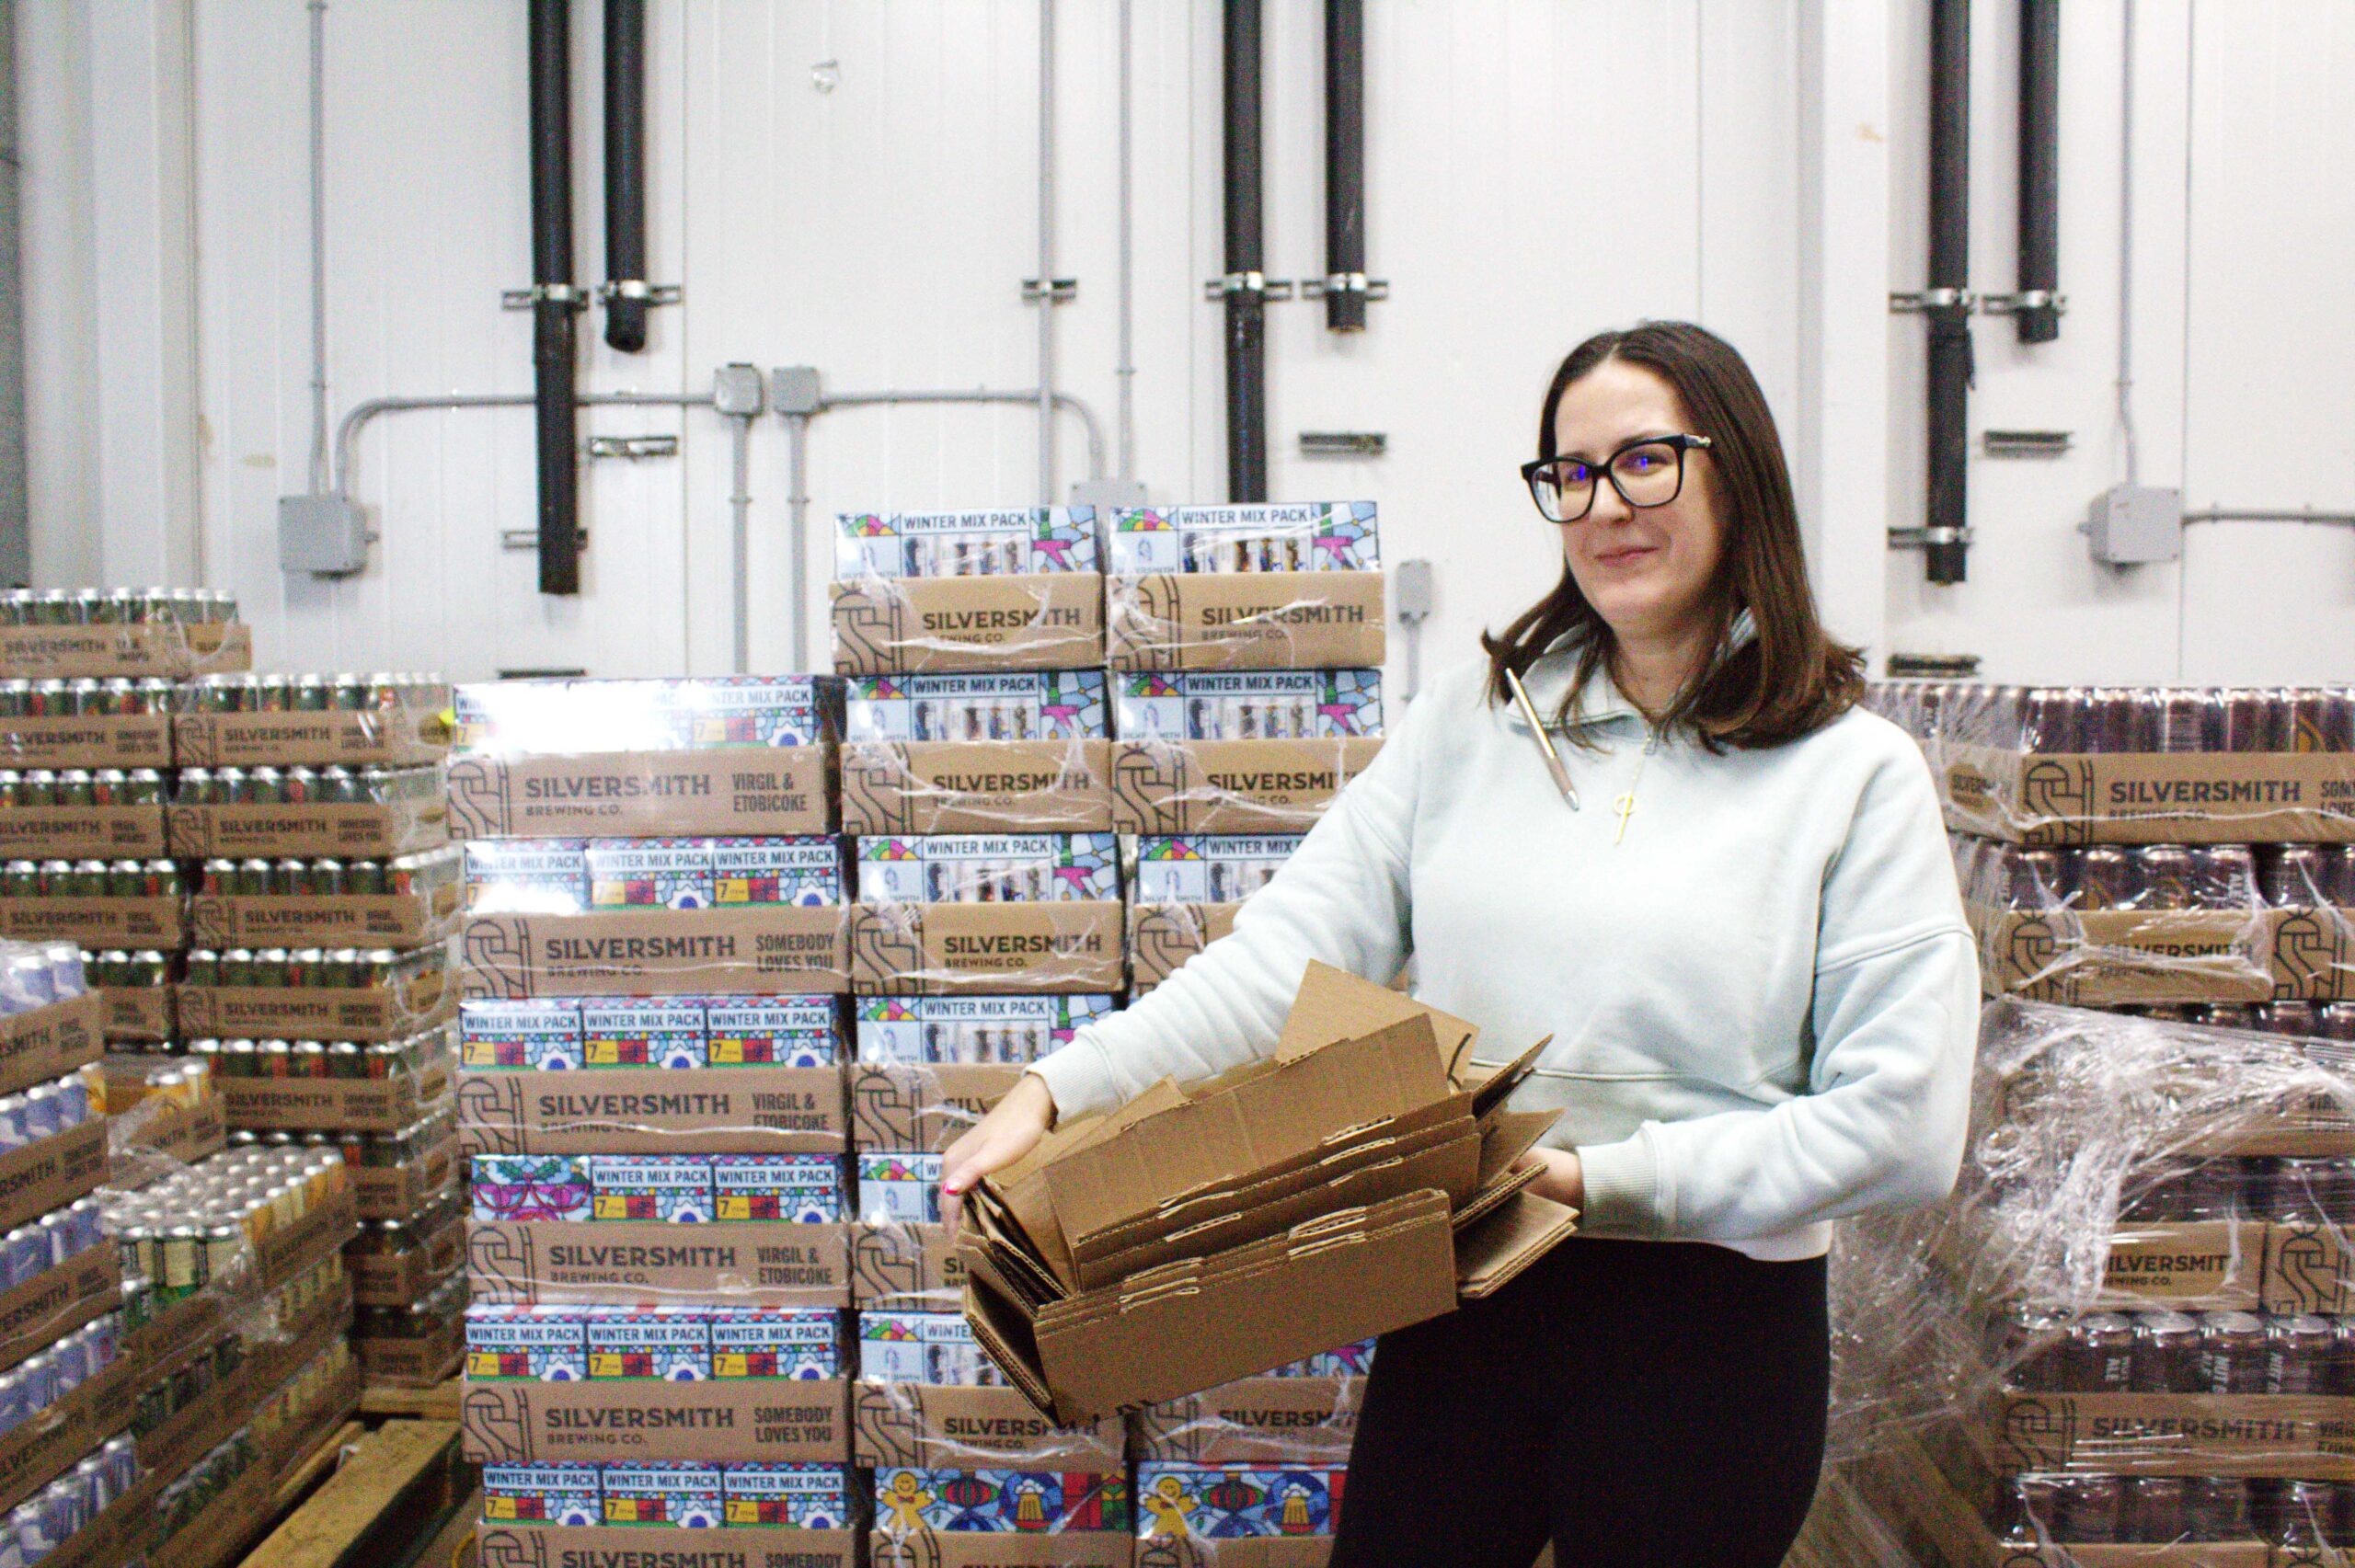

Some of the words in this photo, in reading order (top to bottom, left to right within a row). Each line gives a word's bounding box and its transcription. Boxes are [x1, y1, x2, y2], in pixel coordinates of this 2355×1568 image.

[904, 514, 957, 529] WINTER
[961, 513, 986, 528] MIX
[991, 513, 1027, 527] PACK
[1182, 510, 1235, 524] WINTER
[1241, 509, 1266, 523] MIX
[1271, 509, 1307, 521] PACK
[1201, 605, 1363, 625] SILVERSMITH
[913, 680, 966, 693] WINTER
[971, 679, 996, 692] MIX
[1001, 678, 1035, 691] PACK
[1189, 677, 1241, 691] WINTER
[1246, 677, 1272, 691] MIX
[1276, 676, 1312, 690] PACK
[748, 690, 772, 704] MIX
[775, 689, 810, 703] PACK
[732, 773, 778, 790] VIRGIL
[784, 773, 794, 790] &
[1207, 772, 1355, 791] SILVERSMI
[2109, 780, 2301, 804] SILVERSMITH
[733, 794, 808, 812] ETOBICOKE
[525, 806, 593, 817] BREWING
[926, 841, 979, 854] WINTER
[983, 840, 1008, 853] MIX
[1013, 839, 1048, 853] PACK
[1210, 841, 1261, 854] WINTER
[1267, 840, 1292, 853] MIX
[547, 855, 580, 869] PACK
[649, 853, 671, 867] MIX
[675, 853, 709, 866] PACK
[717, 852, 766, 865] WINTER
[771, 851, 794, 864] MIX
[798, 850, 833, 863] PACK
[718, 882, 728, 899] 7
[546, 936, 736, 959] SILVERSMITH
[755, 933, 835, 952] SOMEBODY
[944, 934, 1101, 955] SILVERSMITH
[757, 956, 801, 972] LOVES
[805, 955, 833, 971] YOU
[945, 958, 1002, 968] BREWING
[1006, 956, 1028, 968] CO.
[925, 1002, 975, 1015] WINTER
[981, 1001, 1005, 1014] MIX
[1012, 1001, 1045, 1013] PACK
[465, 1016, 511, 1029] WINTER
[516, 1016, 539, 1028] MIX
[544, 1015, 577, 1028] PACK
[586, 1015, 635, 1027] WINTER
[639, 1014, 662, 1026] MIX
[667, 1013, 701, 1025] PACK
[710, 1013, 760, 1025] WINTER
[764, 1013, 787, 1024] MIX
[792, 1012, 827, 1024] PACK
[465, 1046, 475, 1060] 7
[588, 1044, 597, 1059] 7
[712, 1043, 722, 1059] 7
[539, 1093, 729, 1116] SILVERSMITH
[752, 1093, 799, 1110] VIRGIL
[805, 1093, 815, 1110] &
[595, 1171, 643, 1184] WINTER
[648, 1170, 671, 1183] MIX
[675, 1170, 707, 1183] PACK
[718, 1171, 766, 1184] WINTER
[771, 1171, 794, 1183] MIX
[798, 1170, 833, 1182] PACK
[596, 1198, 605, 1216] 7
[718, 1199, 729, 1216] 7
[550, 1246, 736, 1267] SILVERSMITH
[756, 1247, 804, 1264] VIRGIL
[808, 1247, 820, 1265] &
[2108, 1253, 2243, 1272] ILVERSMIT
[625, 1273, 649, 1284] CO.
[759, 1267, 832, 1284] ETOBICOKE
[467, 1327, 515, 1340] WINTER
[520, 1328, 543, 1340] MIX
[546, 1327, 580, 1340] PACK
[591, 1328, 640, 1340] WINTER
[644, 1328, 667, 1340] MIX
[672, 1327, 704, 1339] PACK
[714, 1328, 764, 1341] WINTER
[768, 1327, 792, 1339] MIX
[796, 1327, 829, 1339] PACK
[927, 1324, 972, 1338] WINTE
[470, 1356, 479, 1372] 7
[592, 1356, 601, 1372] 7
[717, 1356, 726, 1372] 7
[545, 1407, 734, 1428] SILVERSMITH
[754, 1407, 833, 1424] SOMEBODY
[1219, 1410, 1356, 1426] SILVERSM
[755, 1427, 799, 1443] LOVES
[803, 1426, 833, 1443] YOU
[943, 1417, 1098, 1436] SILVERS
[547, 1434, 617, 1444] BREWING
[485, 1473, 532, 1485] WINTER
[535, 1473, 559, 1485] MIX
[563, 1474, 596, 1486] PACK
[604, 1474, 653, 1486] WINTER
[657, 1475, 679, 1487] MIX
[684, 1475, 717, 1487] PACK
[727, 1476, 775, 1488] WINTER
[779, 1476, 802, 1488] MIX
[807, 1476, 840, 1489] PACK
[487, 1499, 497, 1516] 7
[606, 1502, 616, 1517] 7
[728, 1504, 738, 1520] 7
[562, 1551, 746, 1568] SILVERSMITH
